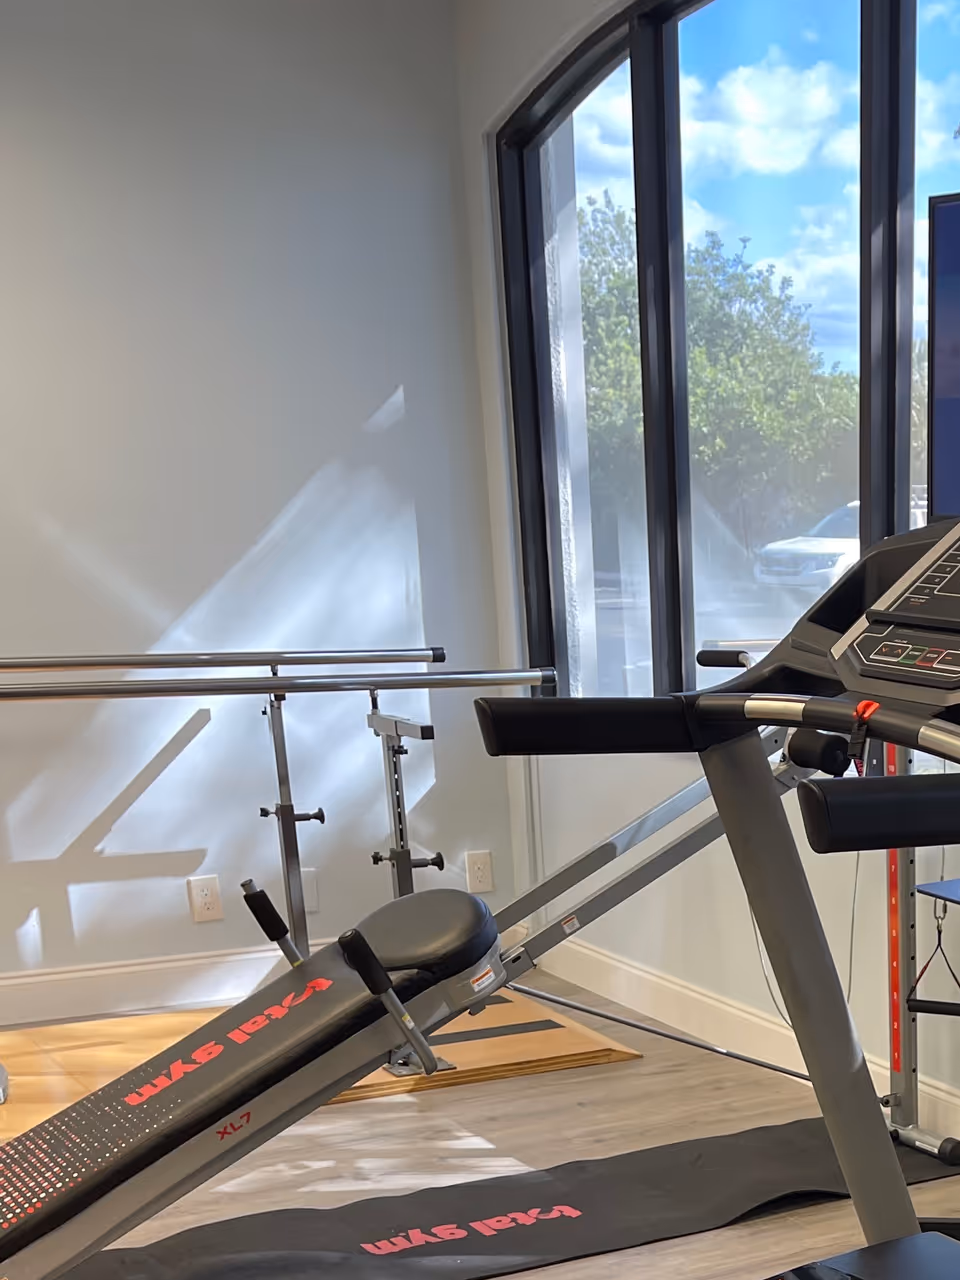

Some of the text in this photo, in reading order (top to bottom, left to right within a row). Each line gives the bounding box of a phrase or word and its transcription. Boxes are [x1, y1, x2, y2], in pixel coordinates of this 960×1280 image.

[123, 977, 334, 1106] total gym
[359, 1204, 583, 1255] total gym
